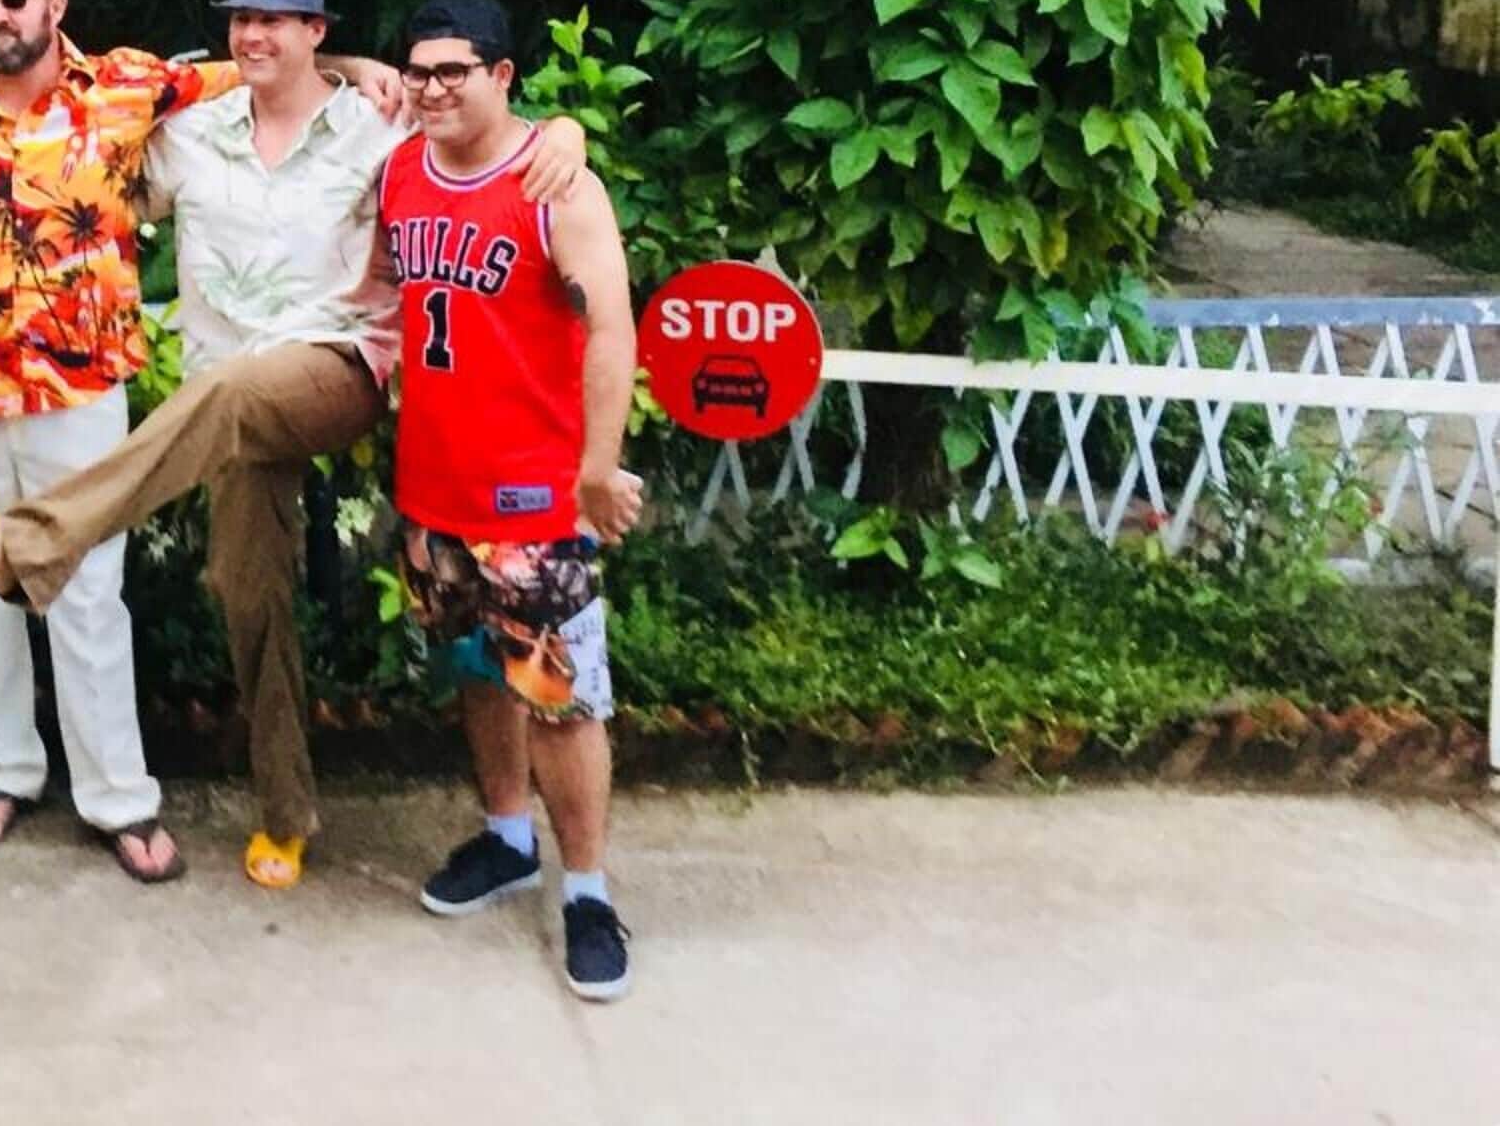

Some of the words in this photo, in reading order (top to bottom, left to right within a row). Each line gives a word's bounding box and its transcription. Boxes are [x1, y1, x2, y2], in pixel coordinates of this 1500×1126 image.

[388, 218, 518, 298] BULLS
[423, 287, 454, 372] 1
[660, 297, 797, 343] STOP
